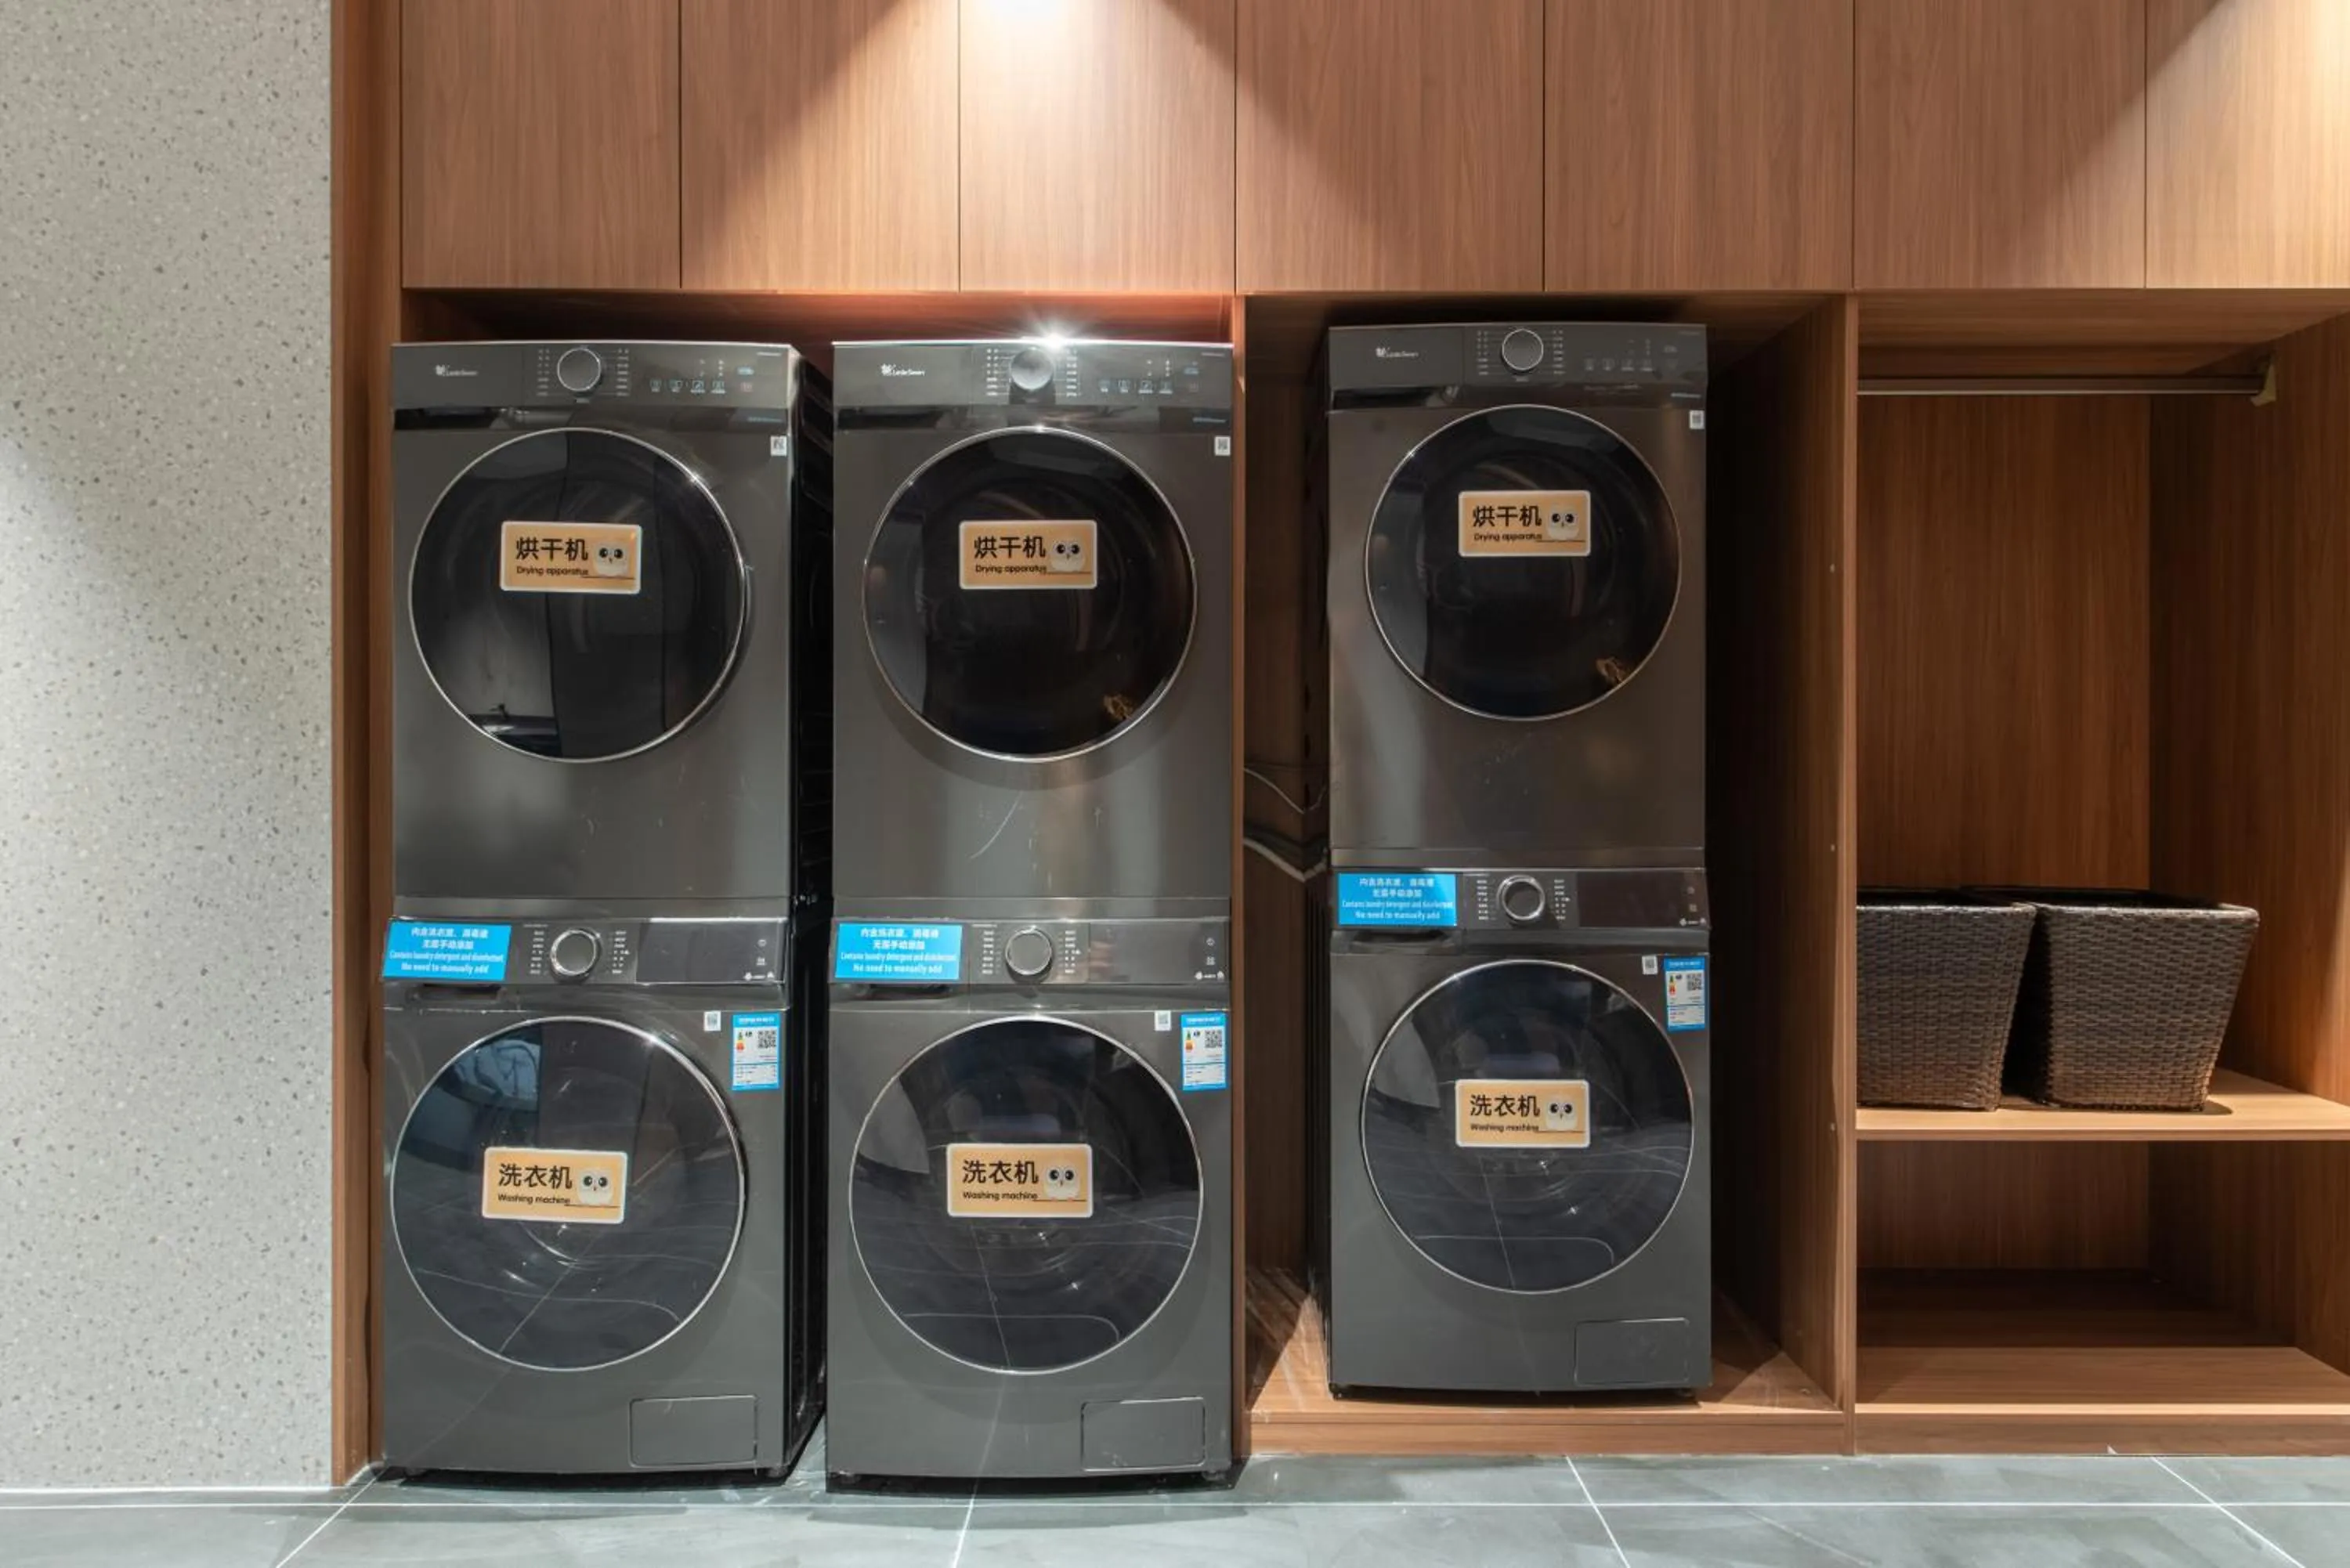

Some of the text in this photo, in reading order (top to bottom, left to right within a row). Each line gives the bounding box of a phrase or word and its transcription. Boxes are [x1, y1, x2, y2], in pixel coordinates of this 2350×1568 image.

[1473, 505, 1542, 527] 烘干机
[1473, 533, 1542, 543] Drying apparatus
[515, 537, 589, 562] 烘干机
[974, 535, 1047, 559] 烘干机
[516, 565, 589, 576] Drying apparatus
[975, 564, 1047, 573] Drying apparatus
[1470, 1093, 1541, 1118] 洗衣机
[1470, 1123, 1504, 1133] Washing
[498, 1163, 573, 1190] 洗衣机
[962, 1158, 1039, 1184] 洗衣机
[497, 1193, 571, 1204] Washing machine
[963, 1191, 1038, 1201] Washing machine
